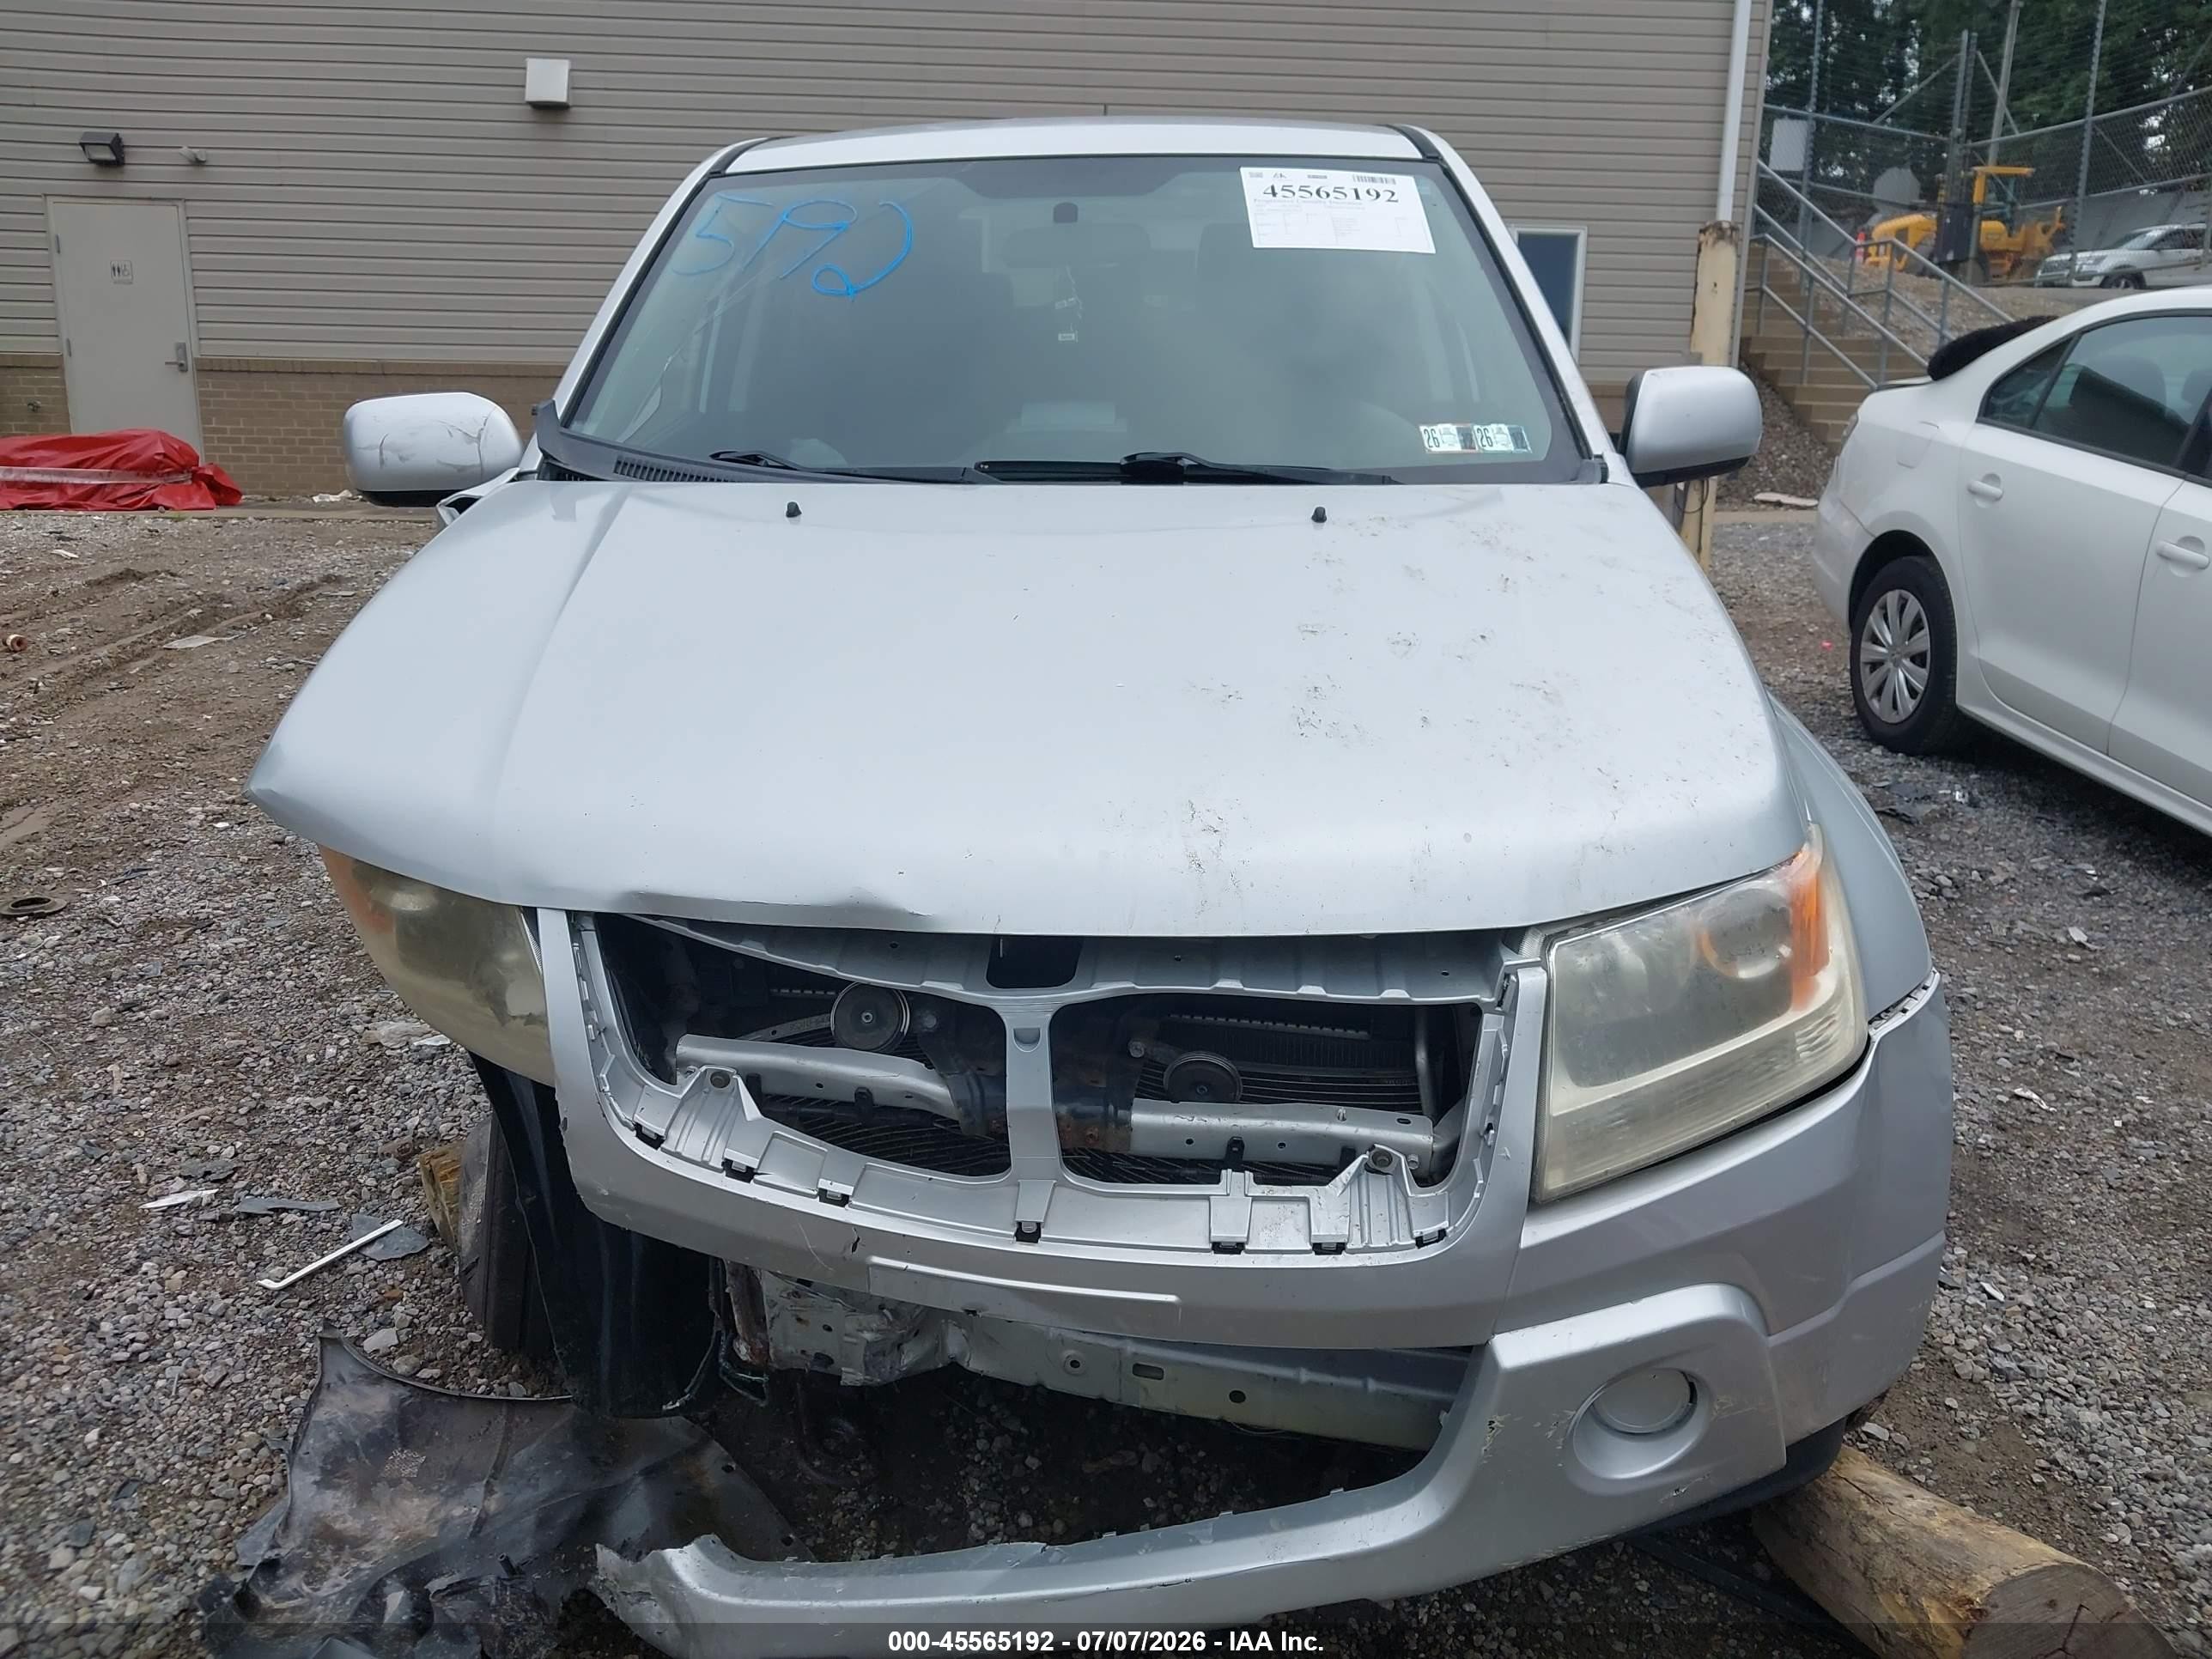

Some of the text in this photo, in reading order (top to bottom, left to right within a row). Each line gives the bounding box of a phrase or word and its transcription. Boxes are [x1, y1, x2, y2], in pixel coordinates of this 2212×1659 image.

[1262, 184, 1399, 203] 45565192
[1424, 428, 1440, 448] 26
[1477, 427, 1493, 447] 26
